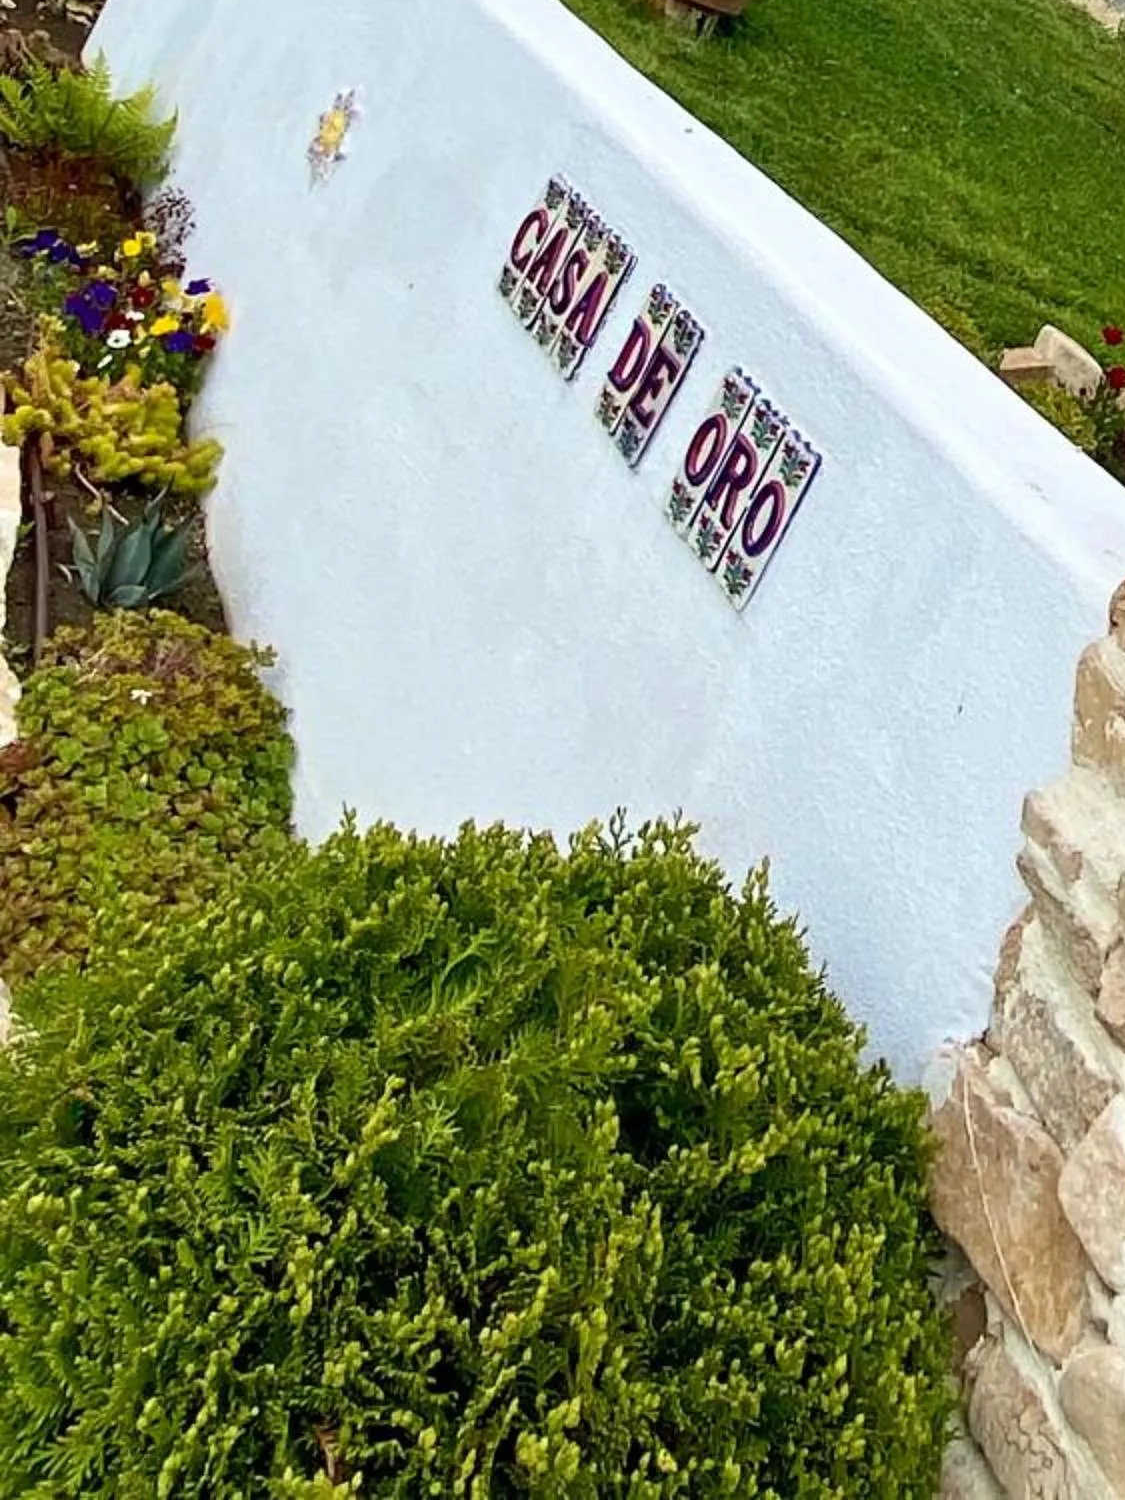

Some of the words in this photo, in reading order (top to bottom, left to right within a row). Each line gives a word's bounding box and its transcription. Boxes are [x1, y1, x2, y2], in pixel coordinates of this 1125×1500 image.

[510, 209, 609, 347] CASA
[607, 318, 681, 429] DE
[685, 414, 785, 557] ORO
